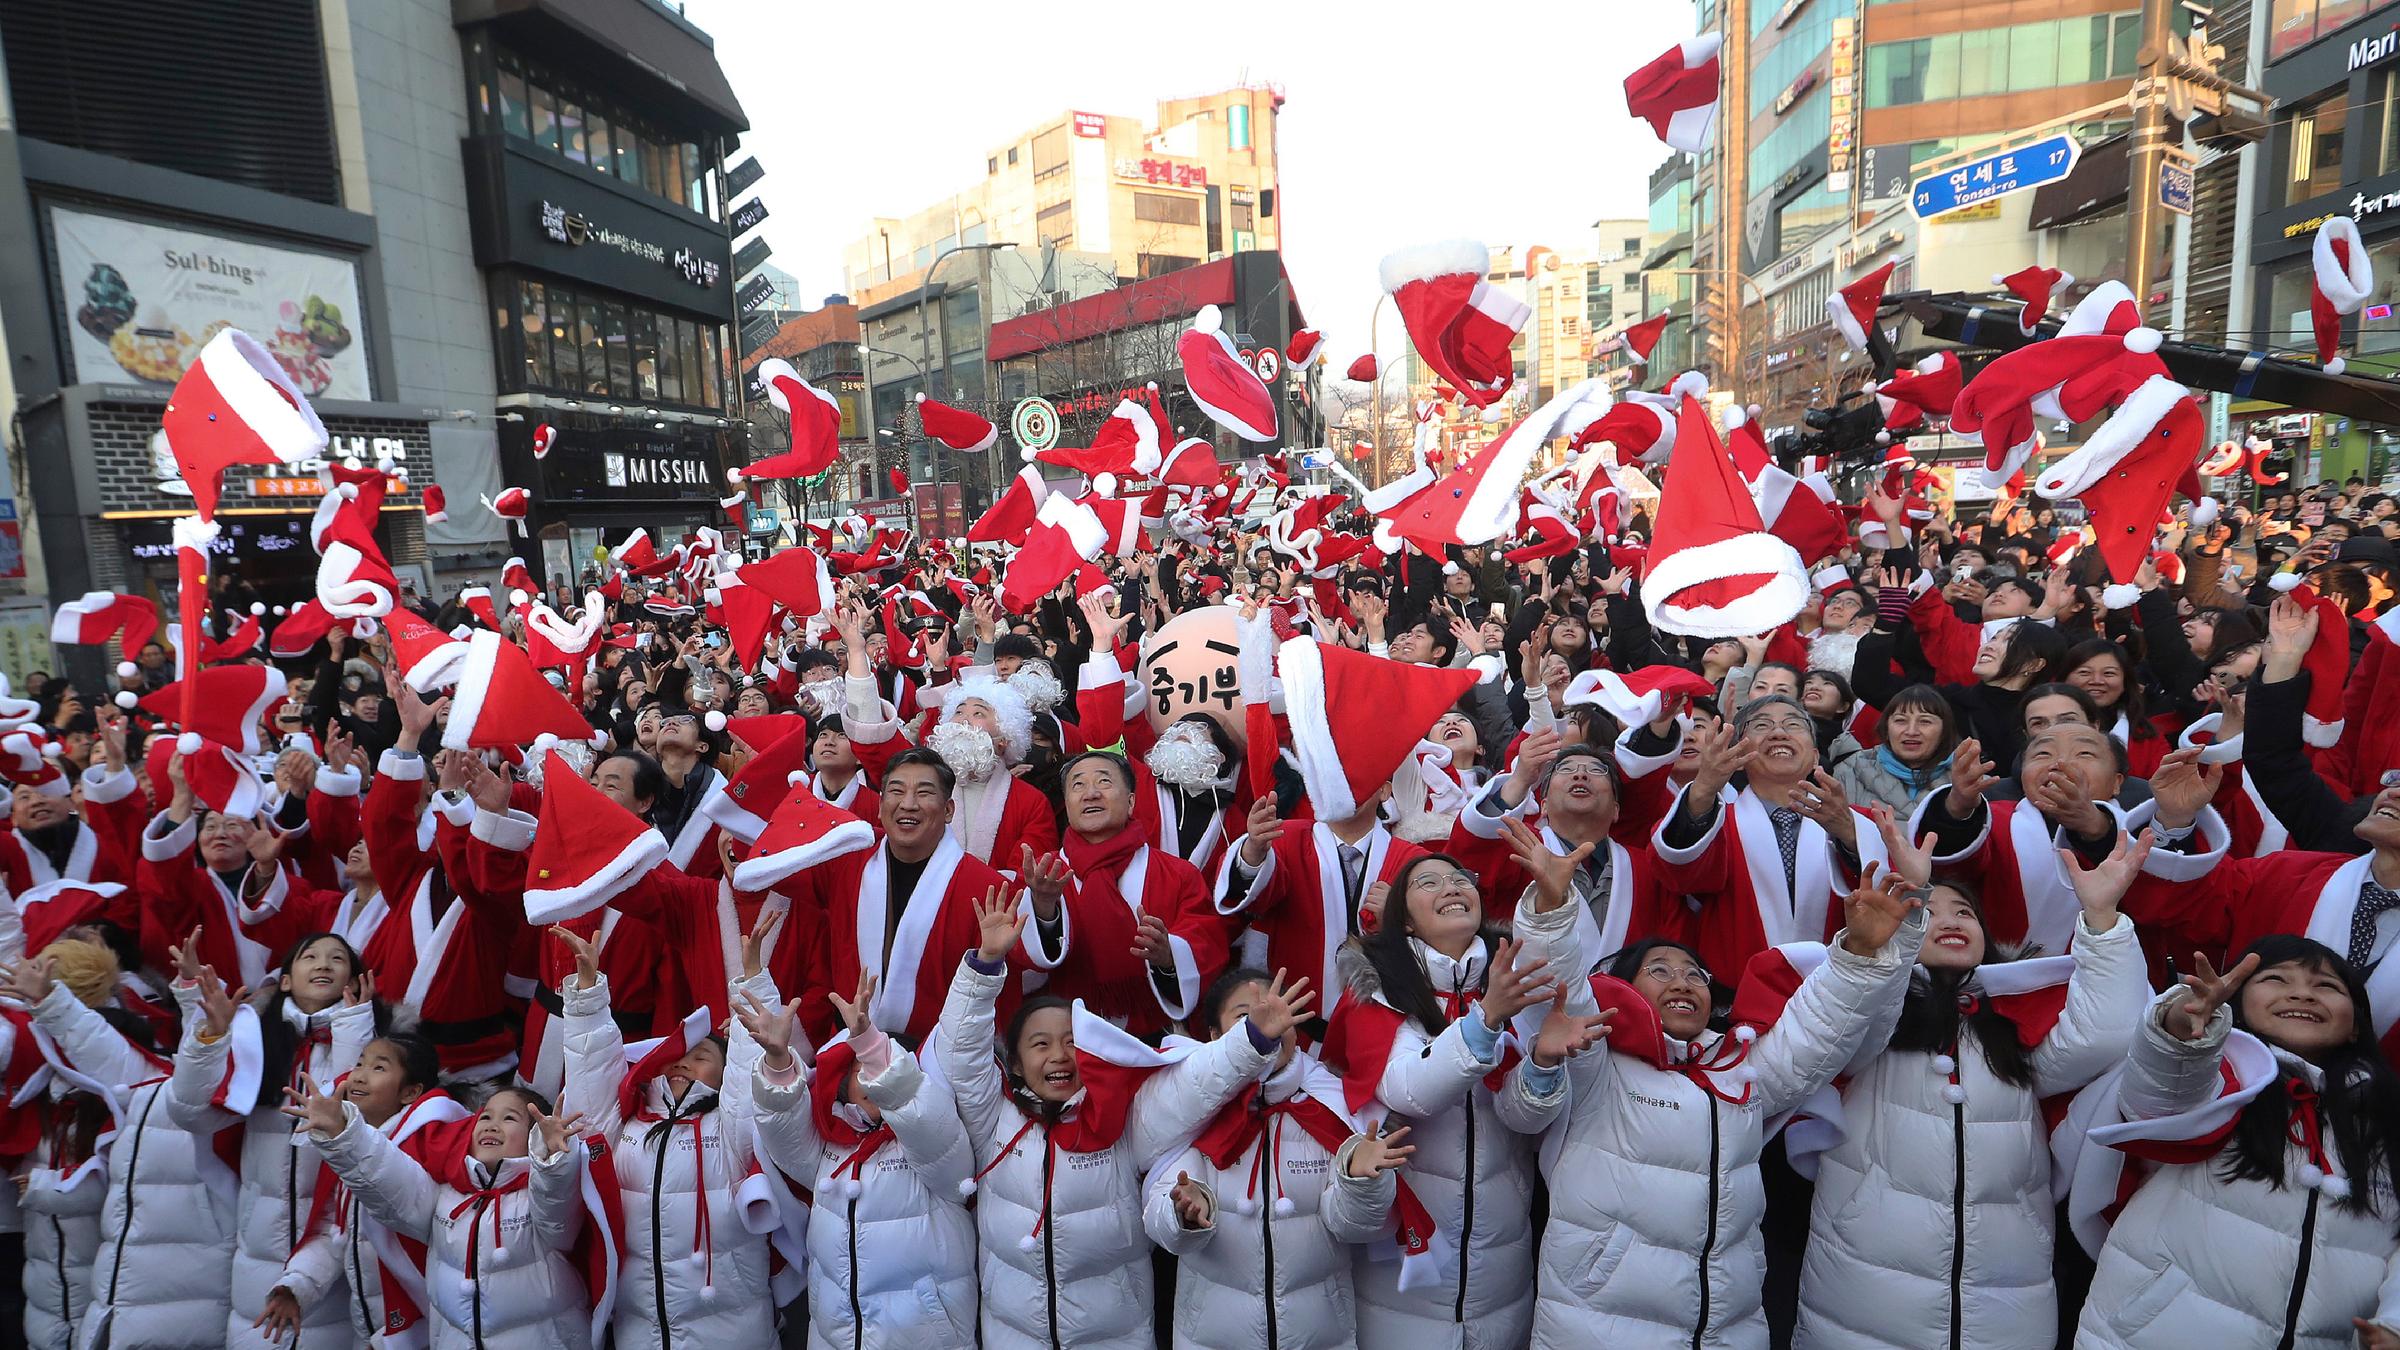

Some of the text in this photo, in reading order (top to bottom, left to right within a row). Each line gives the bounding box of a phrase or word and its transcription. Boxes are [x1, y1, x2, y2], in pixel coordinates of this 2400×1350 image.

[1833, 121, 1849, 132] PC
[2049, 149, 2066, 165] 17
[1140, 158, 1173, 185] 형제
[1176, 164, 1207, 187] 갈비
[1950, 157, 2018, 193] 연세로
[1918, 192, 1930, 206] 21
[1954, 179, 2017, 205] Yonsei-ro
[674, 247, 703, 285] 설빙
[742, 285, 774, 313] MISSHA
[630, 458, 710, 483] MISSHA
[1151, 665, 1241, 716] 중기부
